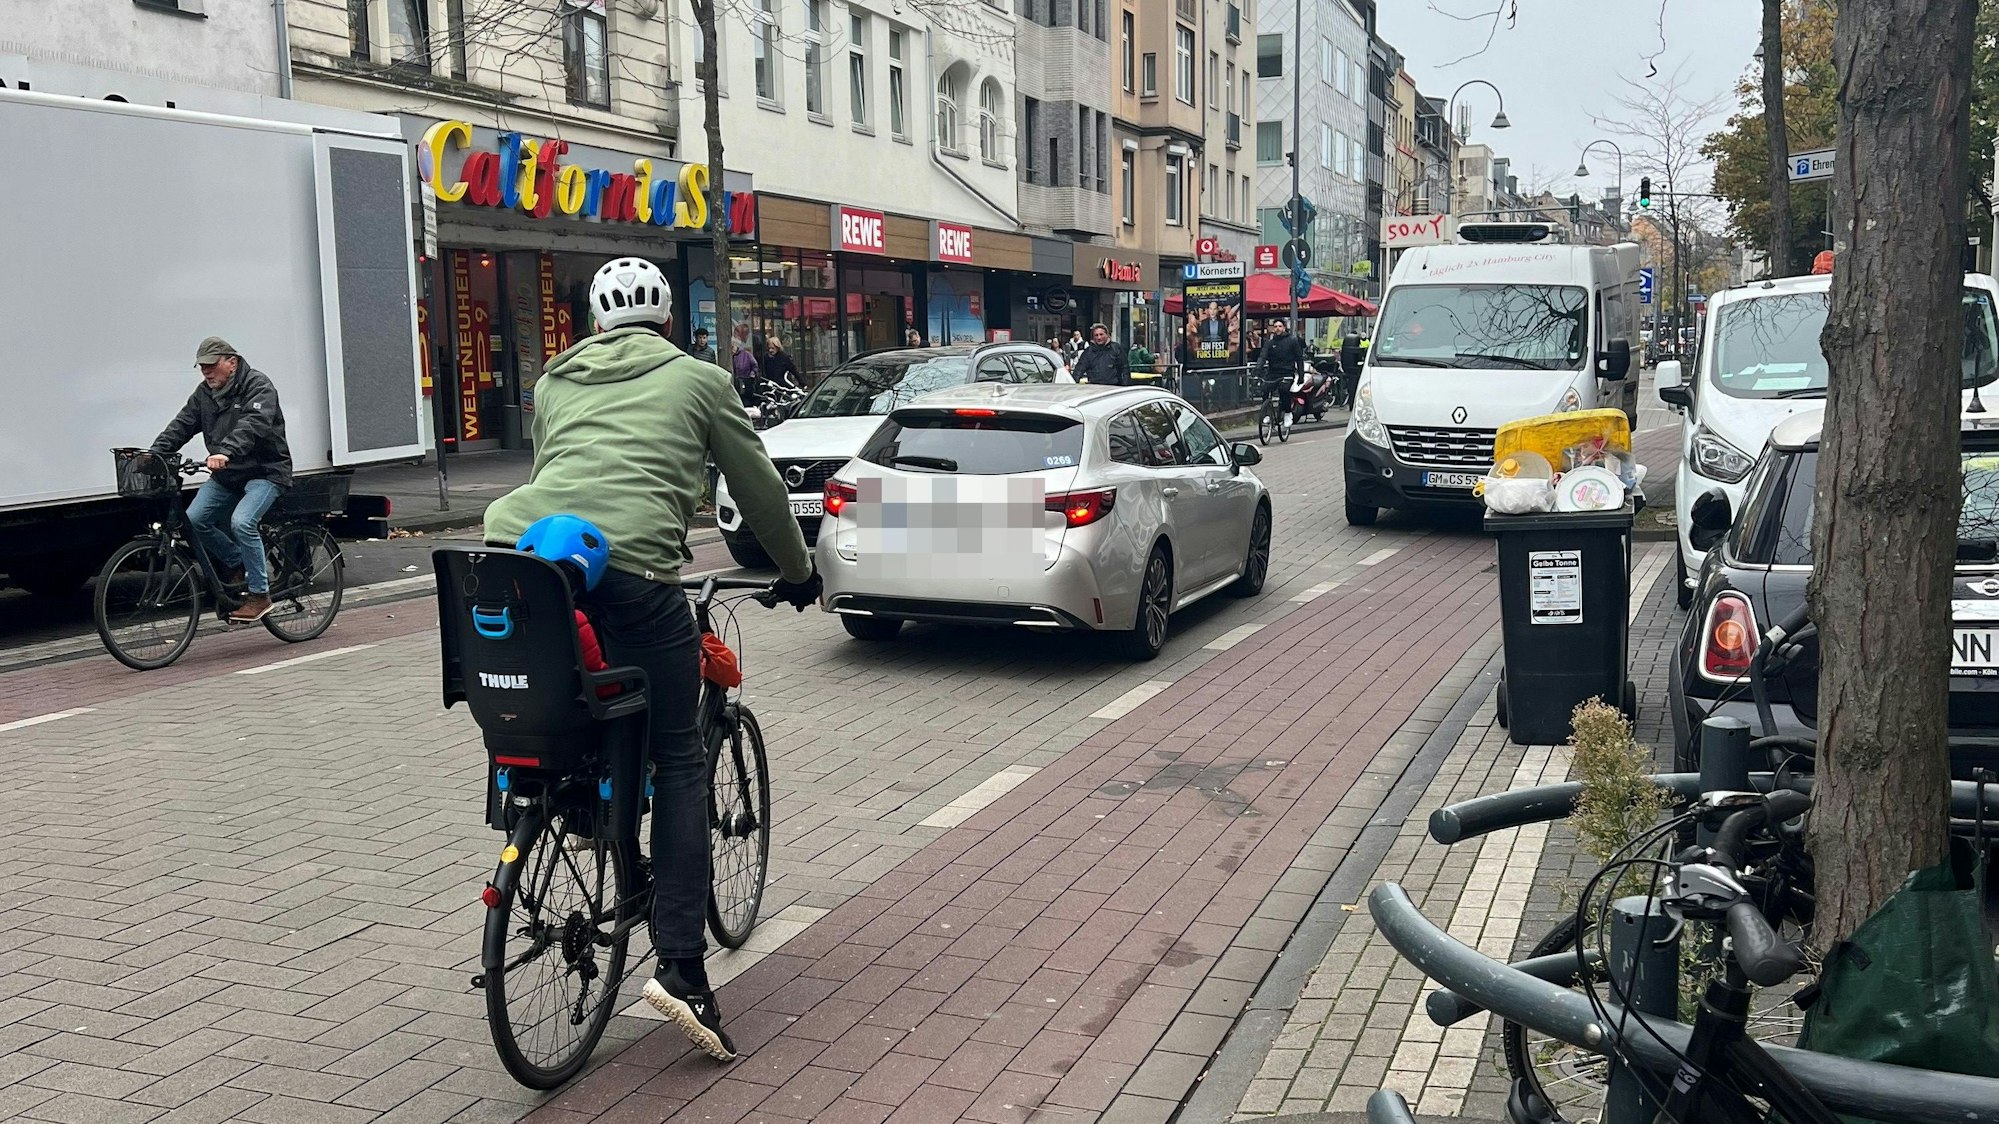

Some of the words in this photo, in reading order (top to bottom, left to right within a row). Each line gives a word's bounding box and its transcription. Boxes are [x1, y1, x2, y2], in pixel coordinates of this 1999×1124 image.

[419, 119, 677, 227] California
[842, 213, 883, 248] REWE
[1388, 214, 1443, 240] SONY
[939, 227, 971, 258] REWE
[1466, 260, 1479, 268] 2x
[1200, 266, 1241, 276] Körnerstr.
[456, 252, 478, 438] WELTNEUHEIT
[1201, 342, 1211, 350] EIN
[1212, 341, 1225, 350] FEST
[1046, 455, 1072, 465] 0269
[1428, 474, 1444, 484] GM
[1449, 475, 1463, 486] CS
[802, 502, 822, 514] 555
[1982, 668, 1998, 676] Köln
[479, 672, 529, 689] THULE
